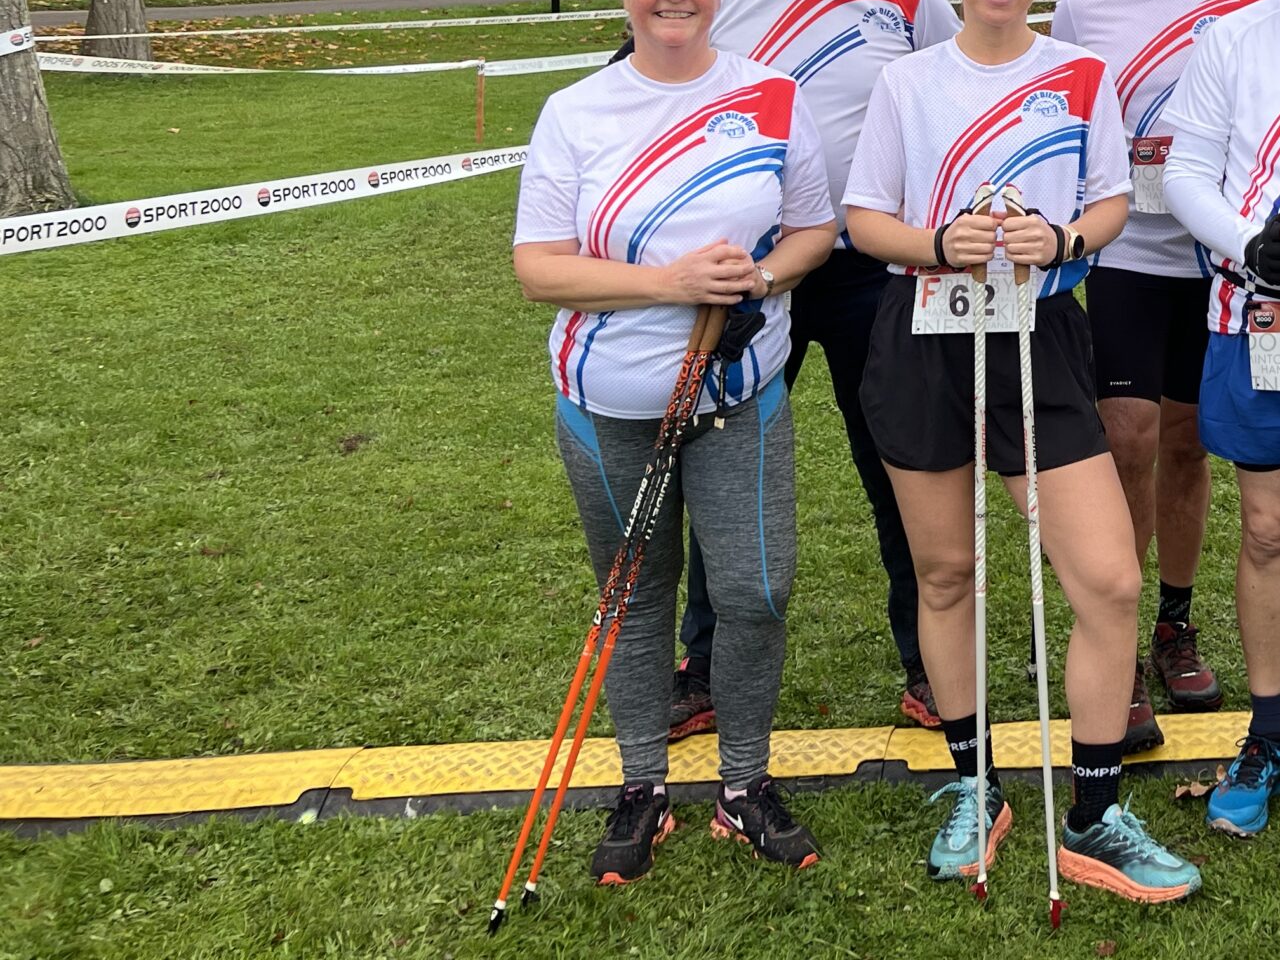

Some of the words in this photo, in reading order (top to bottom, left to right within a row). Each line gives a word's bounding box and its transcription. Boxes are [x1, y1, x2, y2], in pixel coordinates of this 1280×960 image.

[1022, 92, 1040, 112] STADE
[1040, 91, 1067, 111] DIEPPOIS
[707, 114, 724, 133] STADE
[725, 112, 756, 132] DIEPPOIS
[949, 284, 995, 318] 62
